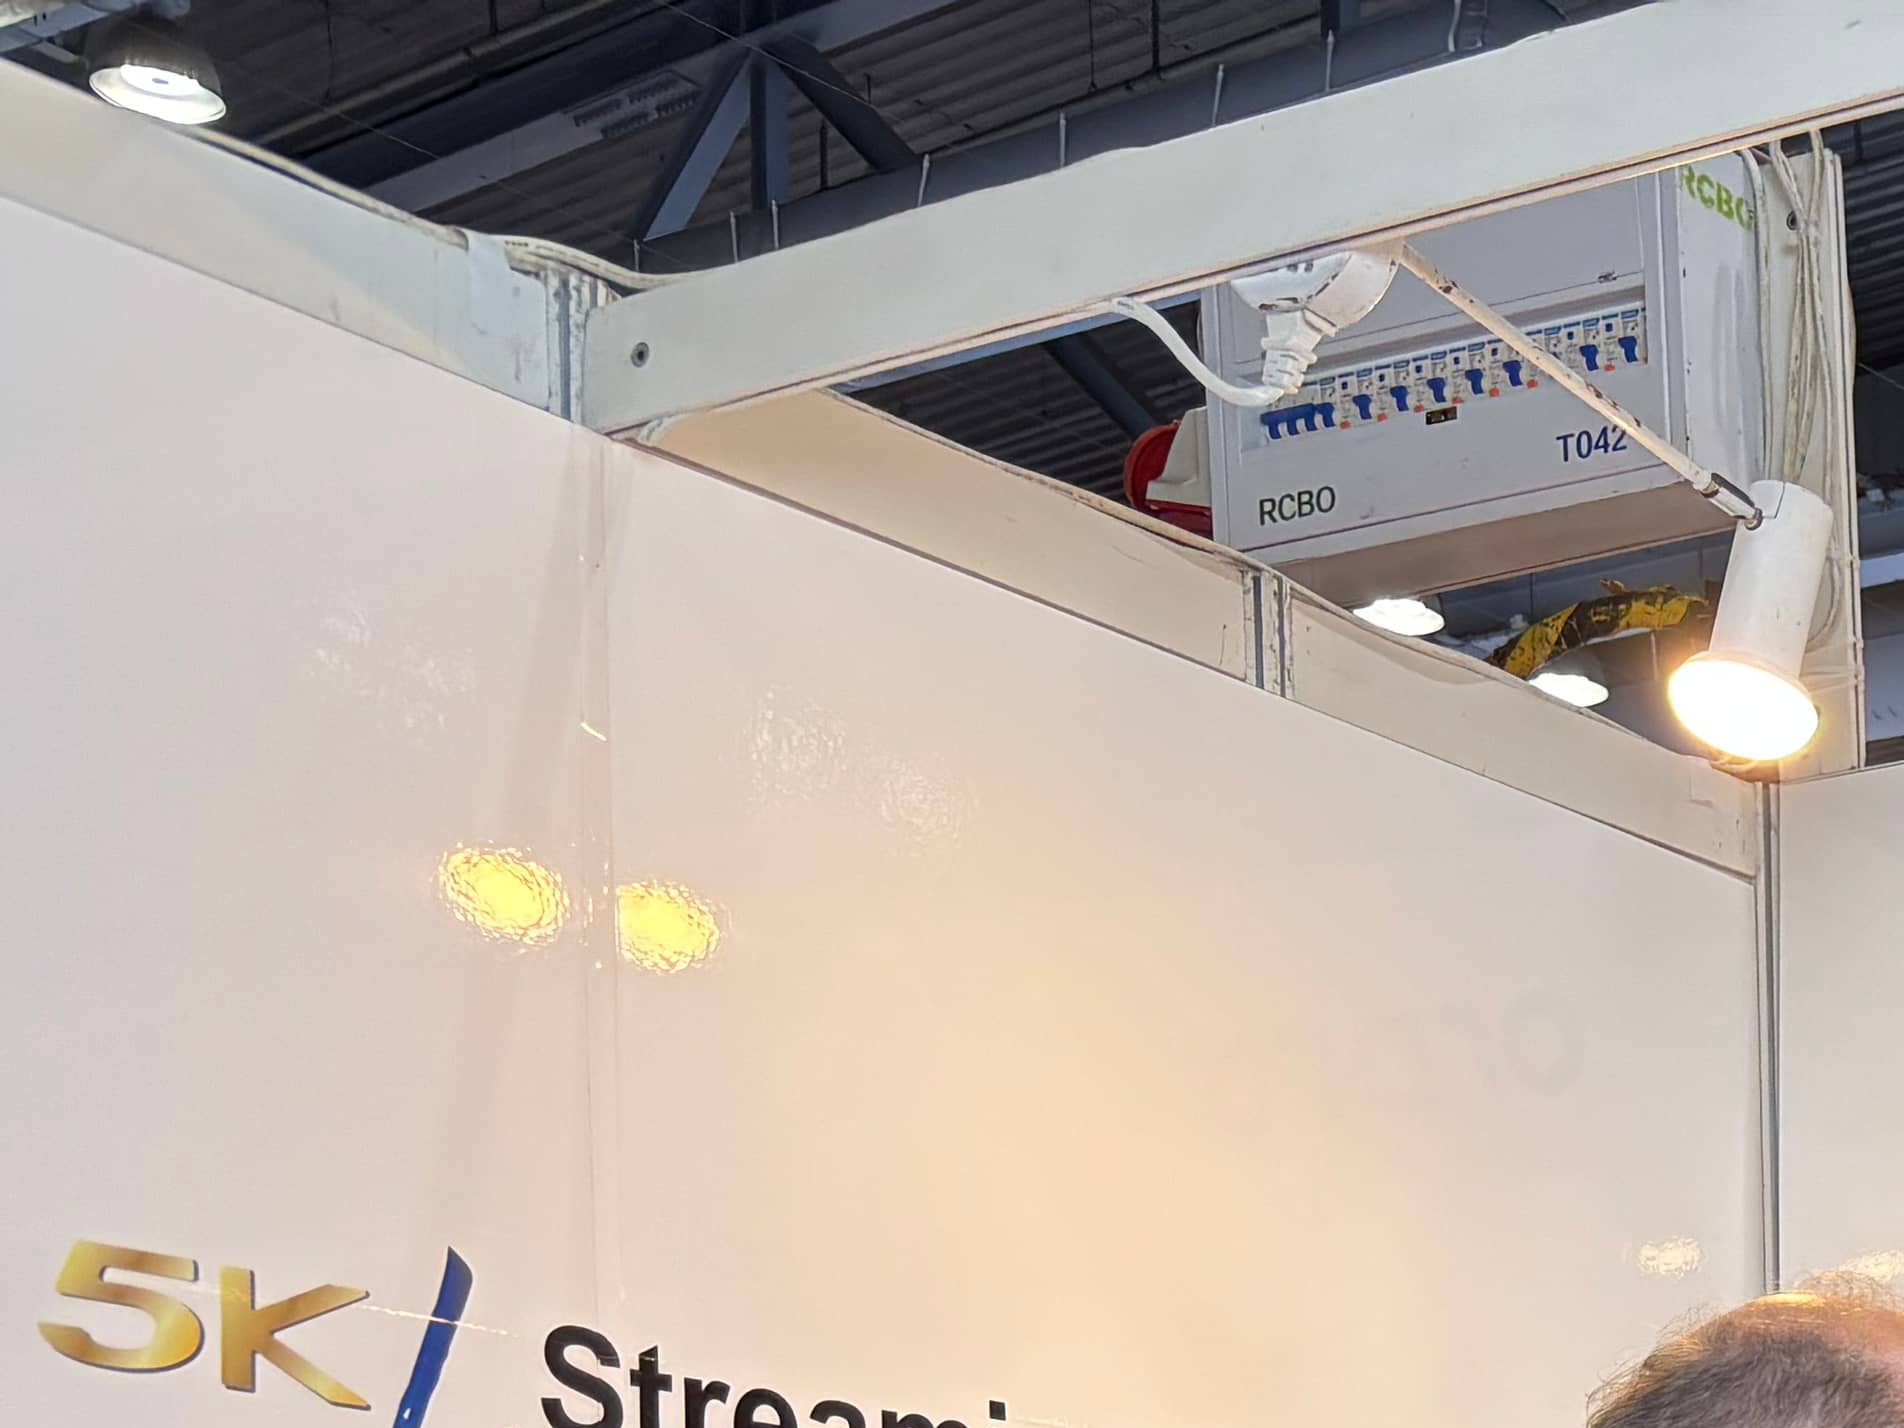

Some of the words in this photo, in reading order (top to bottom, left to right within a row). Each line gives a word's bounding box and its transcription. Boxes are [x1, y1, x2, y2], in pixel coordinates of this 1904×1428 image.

[1555, 425, 1629, 463] T042
[1258, 485, 1336, 526] RCBO
[37, 1239, 371, 1411] 5K
